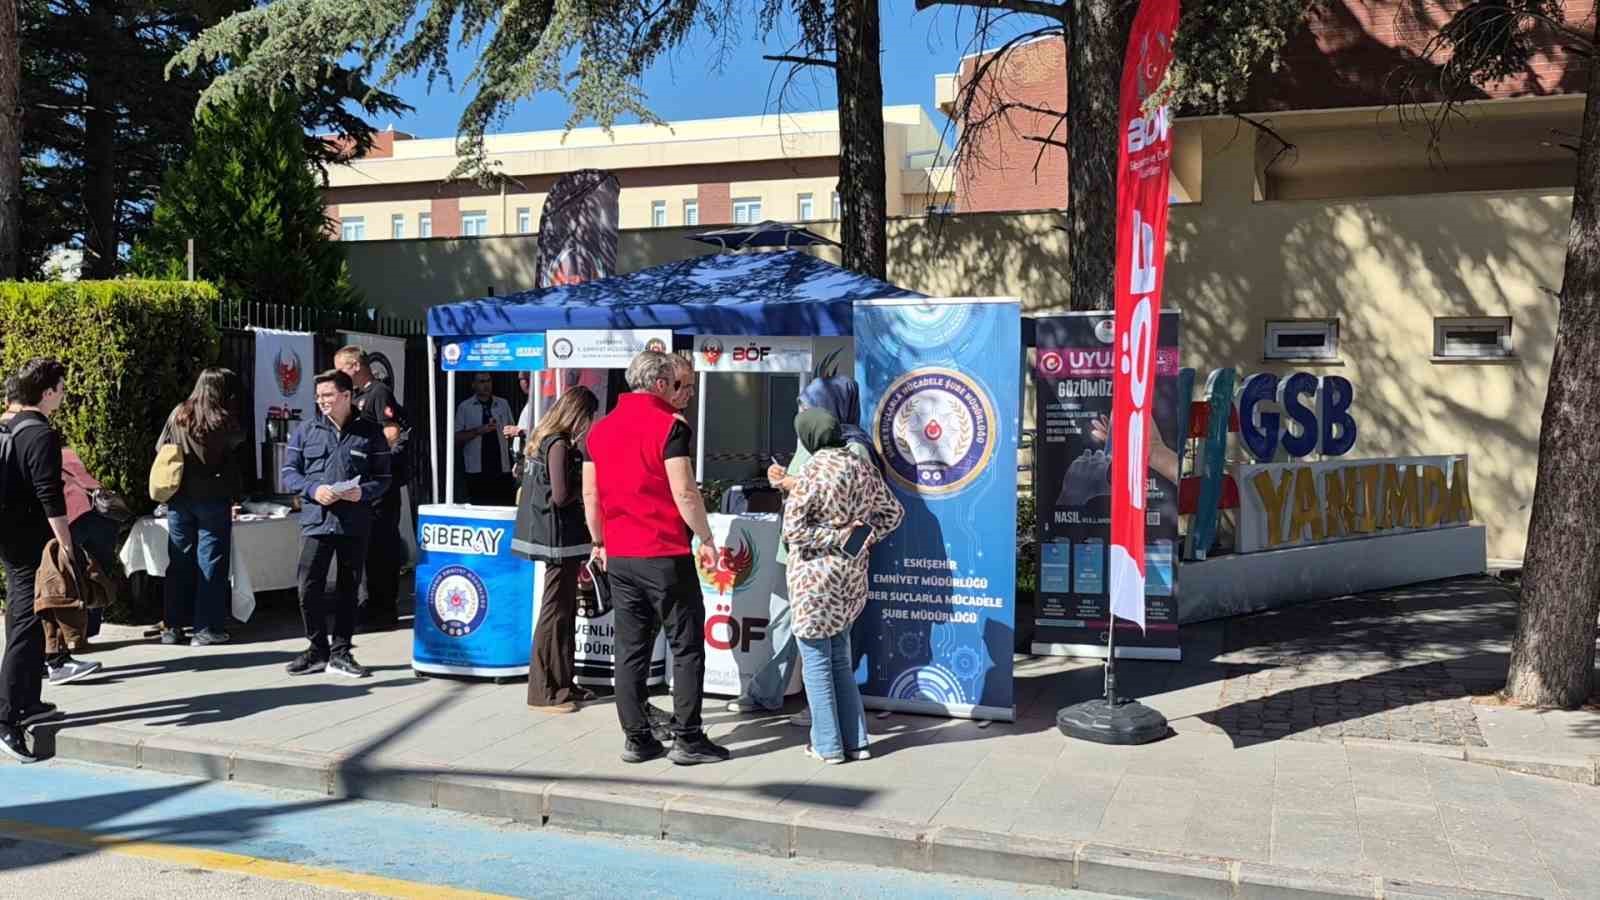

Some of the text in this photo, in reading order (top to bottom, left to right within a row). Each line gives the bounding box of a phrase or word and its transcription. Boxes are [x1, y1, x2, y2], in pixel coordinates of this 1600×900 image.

[732, 342, 772, 362] BÖF
[1255, 459, 1473, 546] YANIMDA
[422, 525, 502, 553] SİBERAY
[903, 558, 957, 570] ESKİŞEHİR
[873, 573, 988, 589] EMNİYET MÜDÜRLÜĞÜ
[868, 591, 1004, 608] BER SUÇLARLA MÜCADELE
[881, 607, 977, 623] ŞUBE MÜDÜRLÜĞÜ
[704, 604, 769, 653] ÖF
